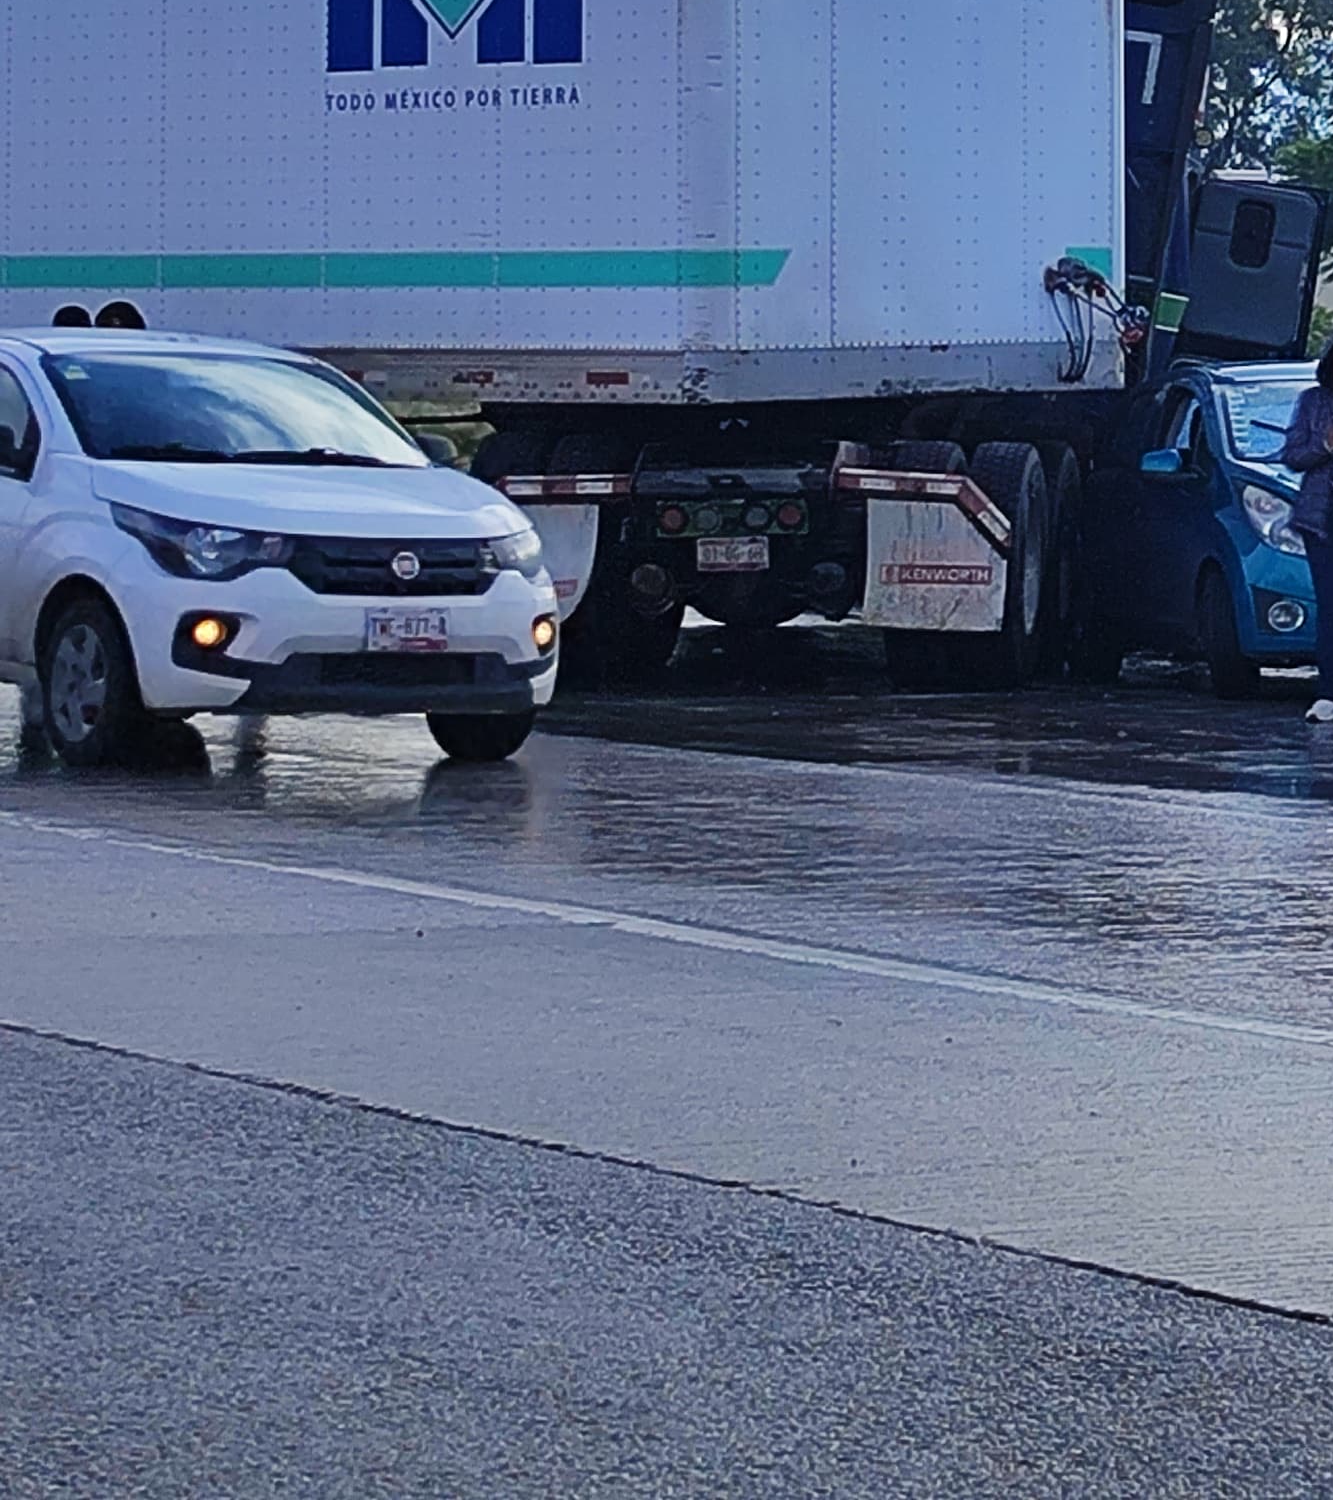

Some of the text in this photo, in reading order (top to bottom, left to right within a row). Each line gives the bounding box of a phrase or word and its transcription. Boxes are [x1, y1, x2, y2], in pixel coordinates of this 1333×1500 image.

[325, 84, 580, 112] TODO MÉXICO POR TIERRA
[901, 567, 990, 582] KENWORTH
